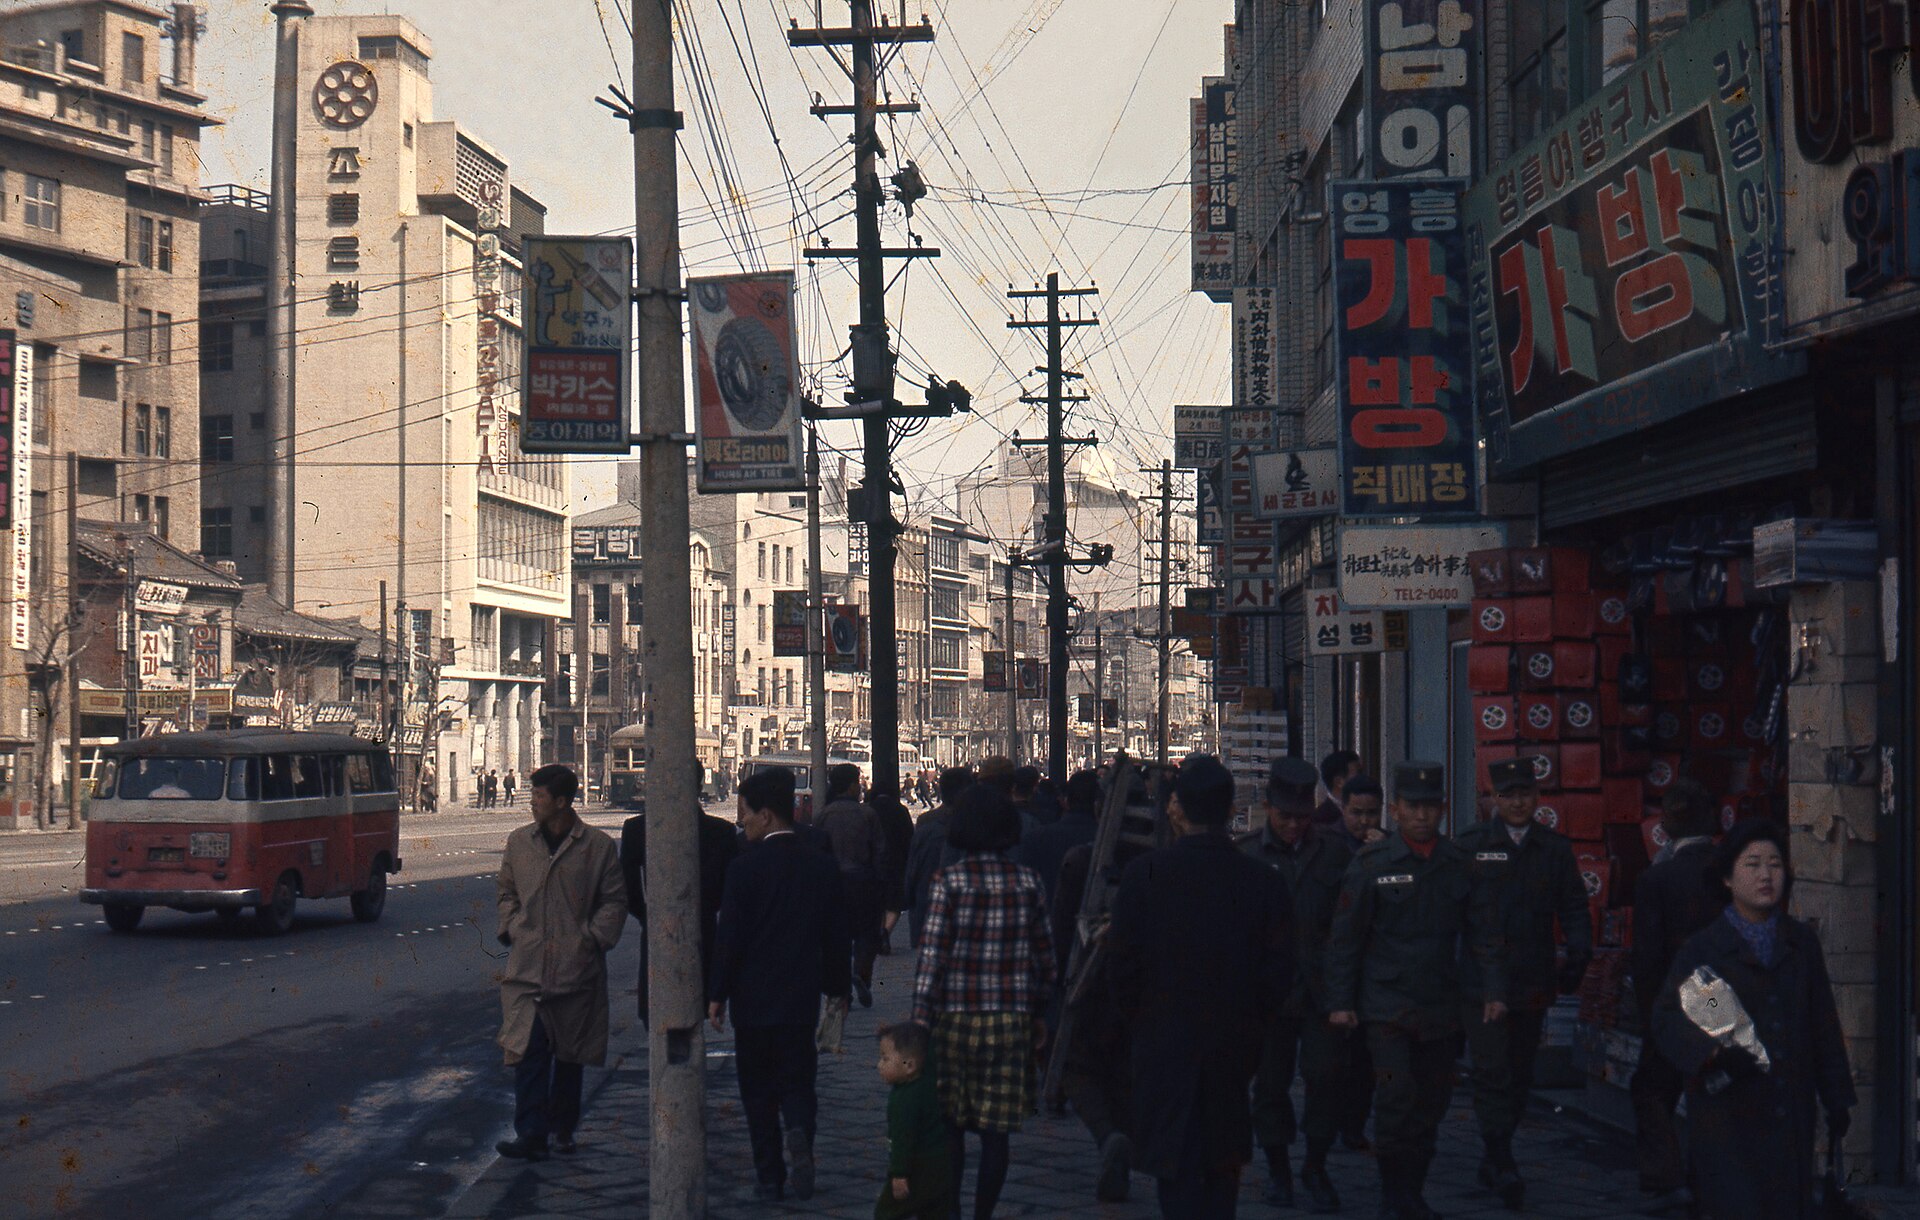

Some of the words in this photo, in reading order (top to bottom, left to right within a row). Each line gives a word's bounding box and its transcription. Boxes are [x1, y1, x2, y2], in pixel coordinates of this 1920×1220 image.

[1378, 0, 1473, 178] 남
[1499, 146, 1708, 398] 가방
[1342, 236, 1448, 450] 가방
[531, 373, 616, 401] 박카스
[527, 421, 619, 441] 동아제약
[1263, 488, 1338, 511] 세균검사
[1351, 461, 1467, 504] 직매장
[142, 633, 159, 676] 치과
[1317, 621, 1372, 648] 성병
